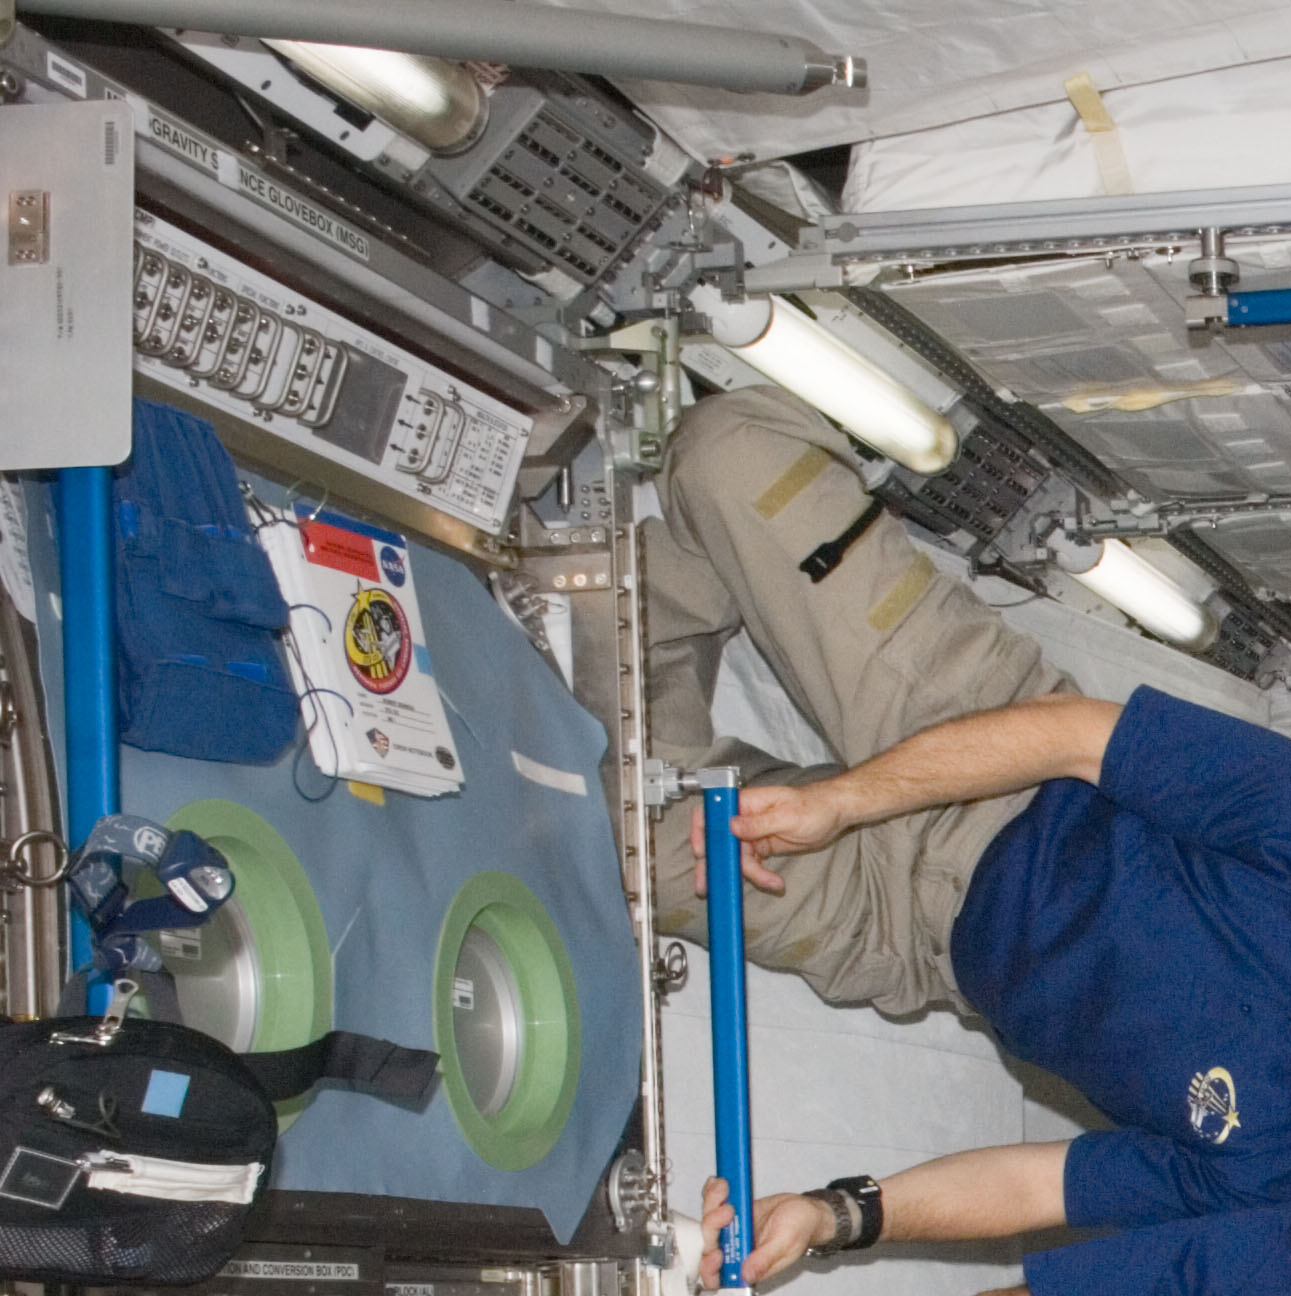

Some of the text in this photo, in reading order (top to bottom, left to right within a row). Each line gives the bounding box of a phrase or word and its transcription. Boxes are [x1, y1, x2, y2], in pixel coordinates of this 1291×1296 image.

[150, 117, 209, 163] GRAVITY
[269, 186, 334, 235] GLOVEBOX
[336, 226, 369, 257] (MSG)
[382, 559, 404, 575] NASA
[244, 1263, 260, 1275] AND
[262, 1264, 314, 1276] CONVERSION
[316, 1265, 331, 1277] BOX
